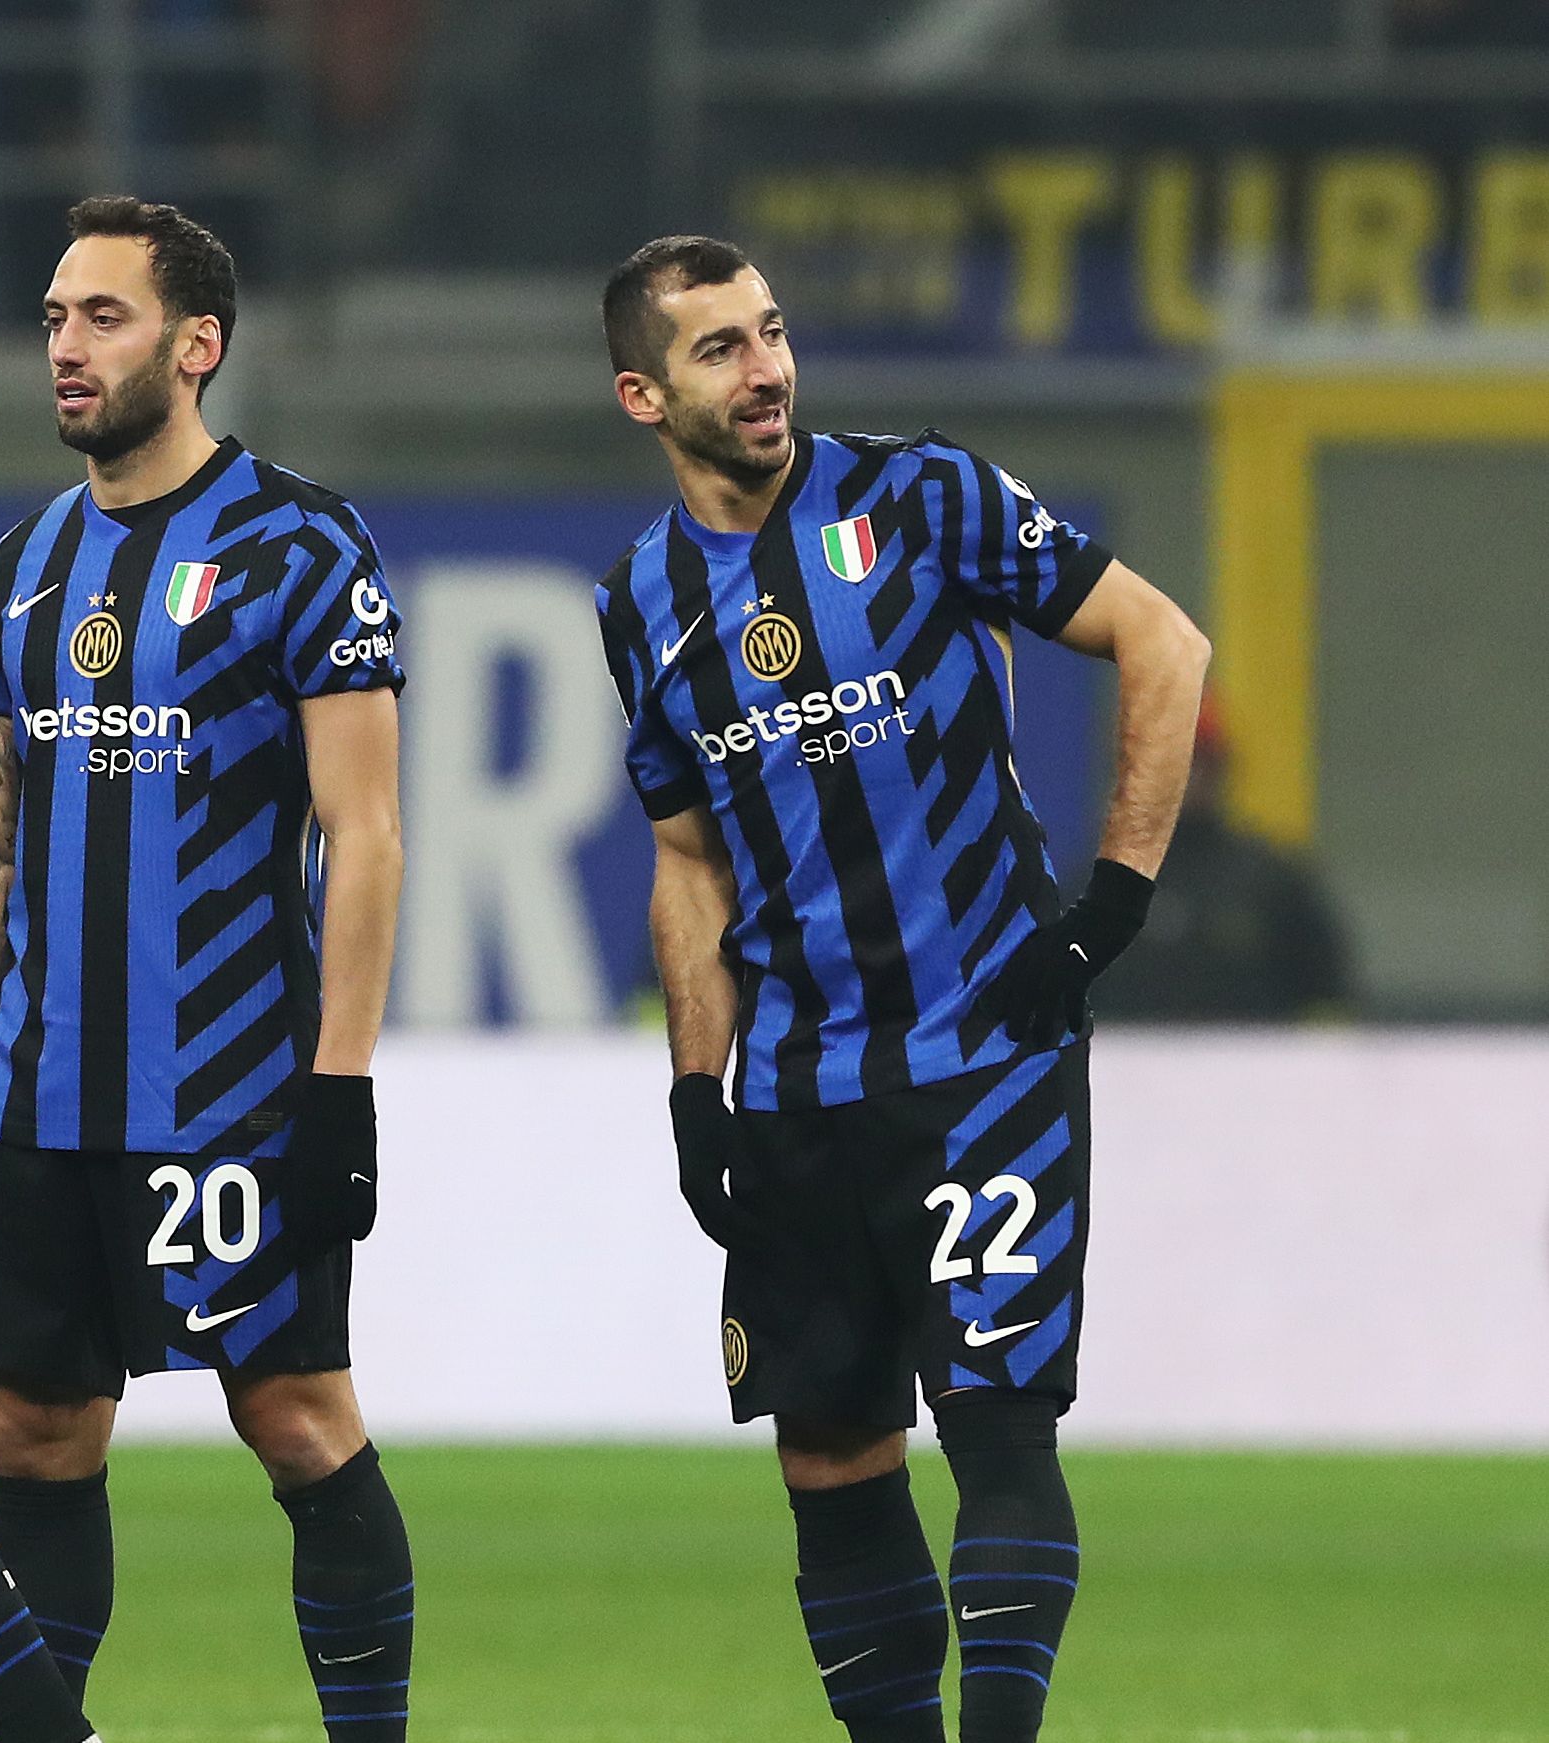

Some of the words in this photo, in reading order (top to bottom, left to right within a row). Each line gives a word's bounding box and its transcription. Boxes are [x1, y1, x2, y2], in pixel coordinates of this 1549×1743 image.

[79, 744, 191, 780] .sport
[690, 670, 906, 764] betsson
[147, 1163, 261, 1266] 20
[923, 1174, 1039, 1284] 22
